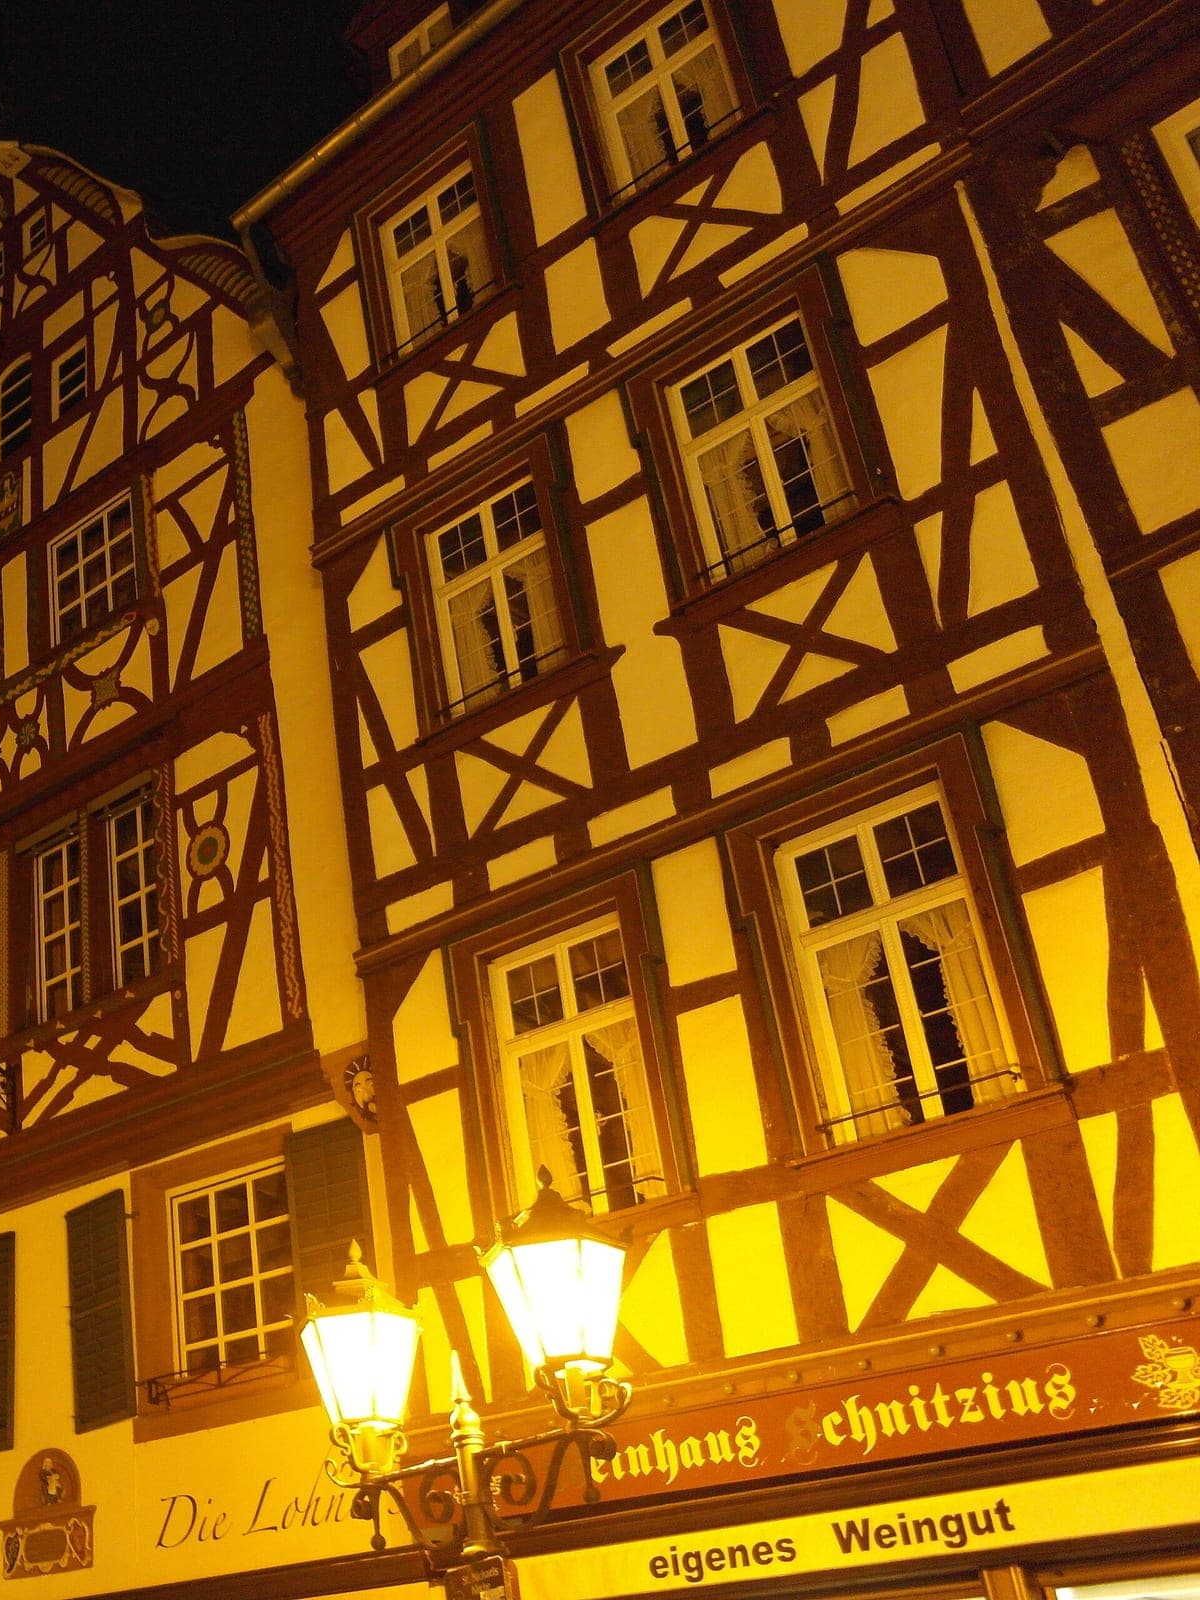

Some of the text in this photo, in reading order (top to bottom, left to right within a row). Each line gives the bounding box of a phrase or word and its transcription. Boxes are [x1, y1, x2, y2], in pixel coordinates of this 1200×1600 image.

[570, 1362, 1076, 1485] einhaus Schnitzius
[156, 1494, 229, 1549] Die
[649, 1498, 1016, 1583] eigenes Weingut
